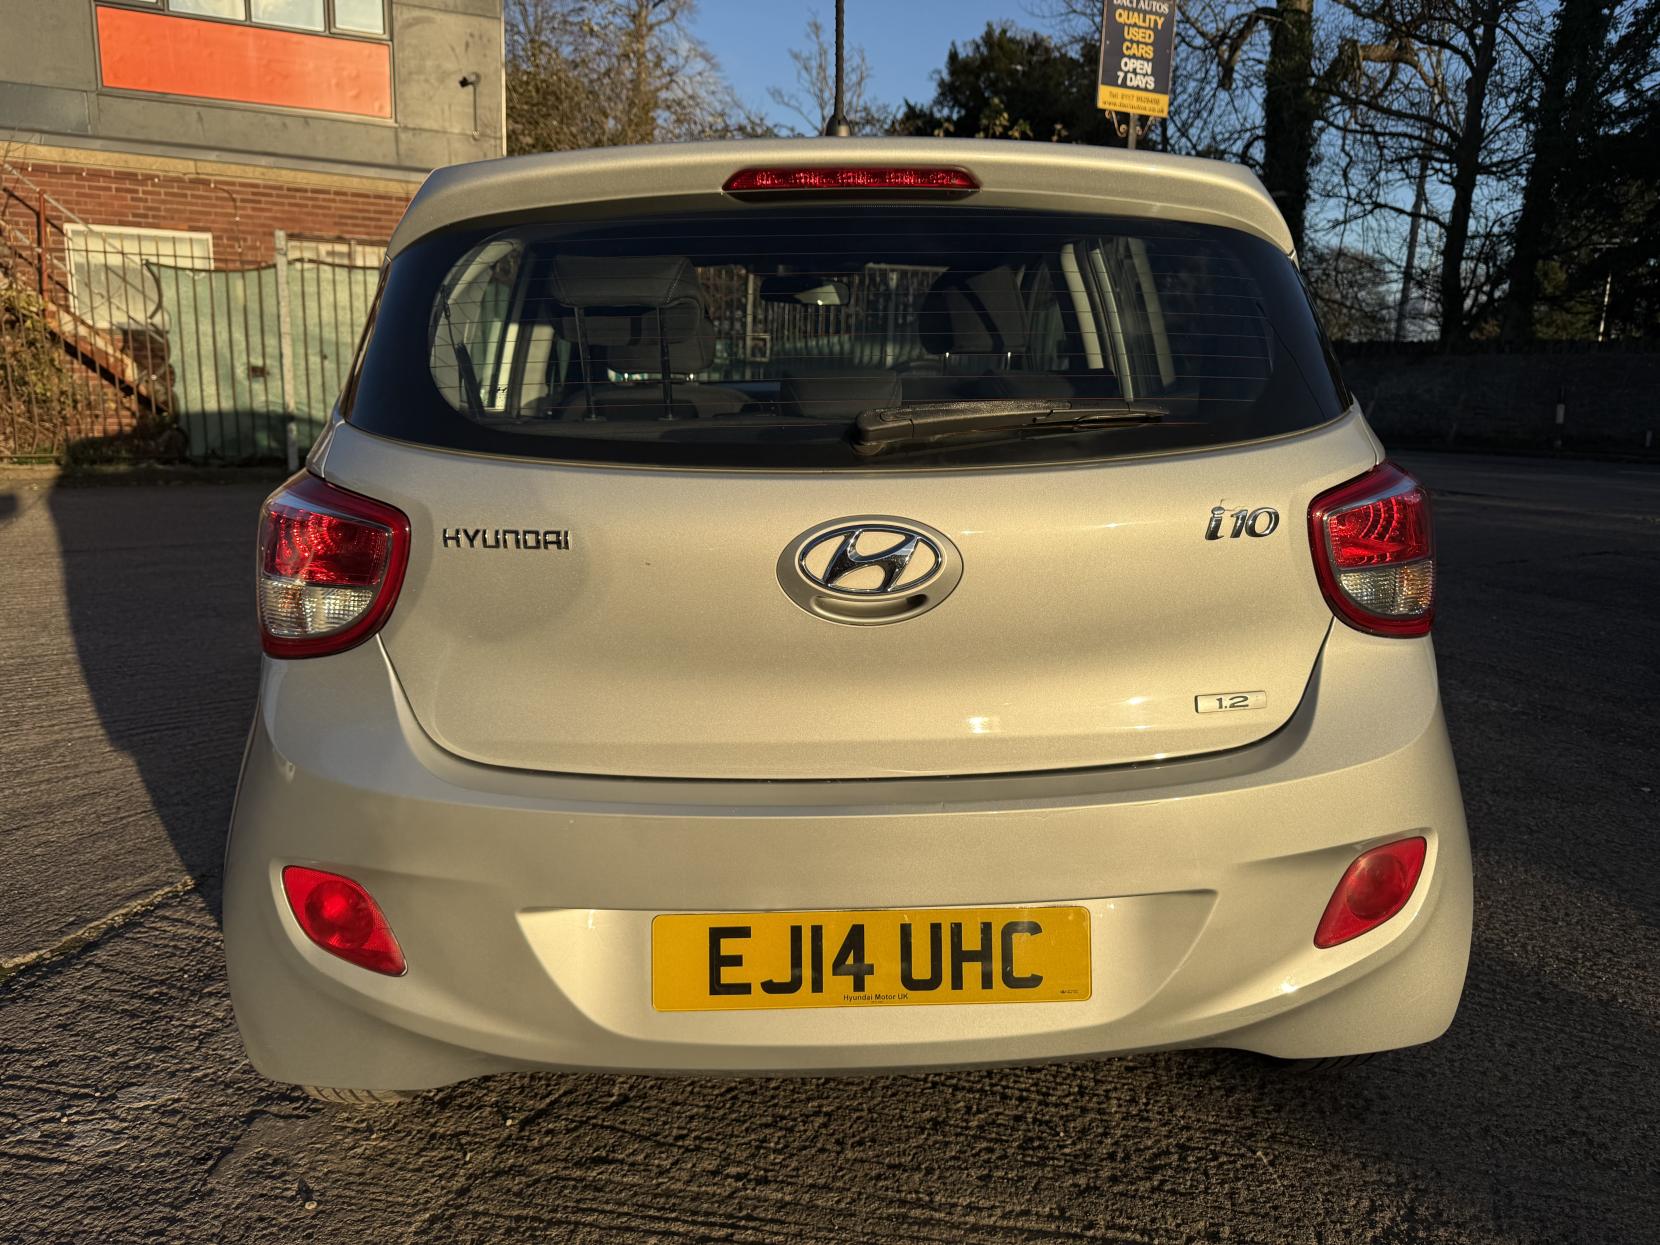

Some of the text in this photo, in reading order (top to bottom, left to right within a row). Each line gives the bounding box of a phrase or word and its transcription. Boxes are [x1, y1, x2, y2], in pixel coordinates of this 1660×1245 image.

[1138, 0, 1169, 15] AUTOS
[1115, 8, 1164, 30] QUALITY
[1124, 25, 1155, 43] USED
[1122, 41, 1154, 59] CARS
[1121, 57, 1153, 75] OPEN
[1117, 70, 1155, 90] 7 DAYS
[1205, 506, 1280, 540] i10
[443, 528, 570, 550] HYUNDAI
[1216, 695, 1249, 709] 1.2
[708, 920, 1044, 996] EJ14 UHC
[843, 993, 873, 1003] Hyundai
[897, 992, 909, 1000] UK
